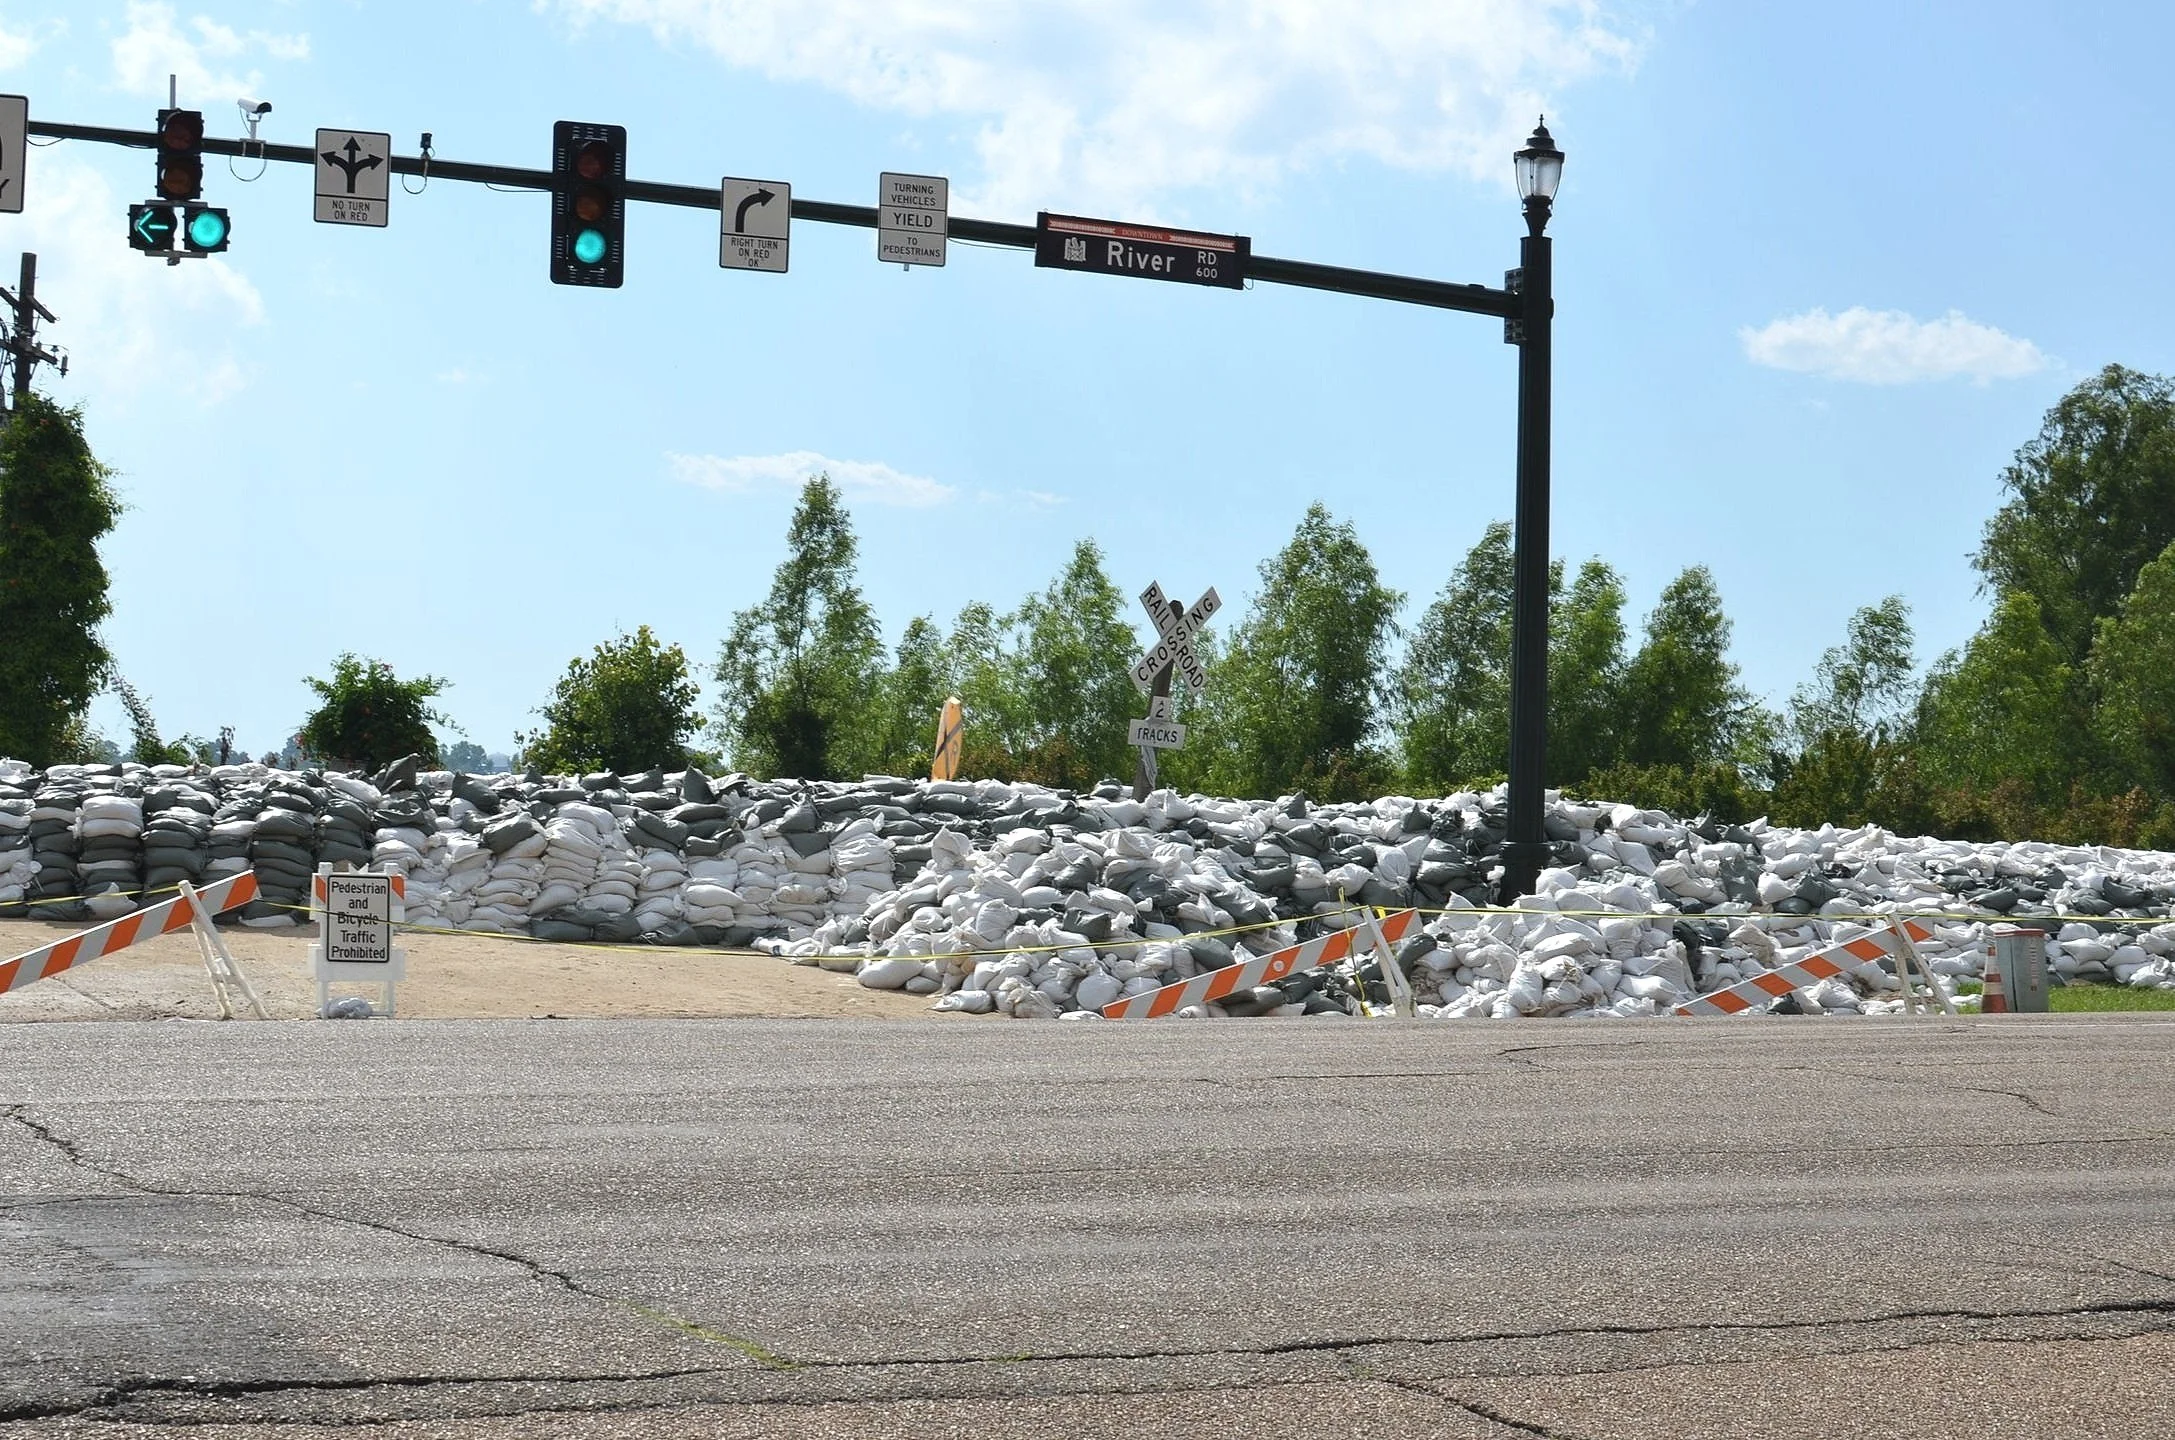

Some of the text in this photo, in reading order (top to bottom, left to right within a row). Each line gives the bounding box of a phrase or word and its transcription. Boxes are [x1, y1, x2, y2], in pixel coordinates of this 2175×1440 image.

[894, 183, 934, 194] TURNING
[332, 200, 370, 211] NO TURN
[891, 194, 936, 206] VEHICLES
[334, 211, 368, 221] ON RED
[893, 212, 933, 228] YIELD
[1121, 229, 1163, 240] DOWNTOWN
[731, 237, 778, 249] RIGHT TURN
[907, 237, 918, 246] TO
[738, 247, 770, 258] ON RED
[883, 245, 940, 258] PEDESTRIANS
[1107, 240, 1217, 273] River RD
[748, 258, 760, 267] OK
[1196, 267, 1218, 279] 600
[1137, 597, 1214, 682] CROSSING
[1144, 586, 1204, 688] RAIL ROAD
[1155, 701, 1164, 718] 2
[1136, 727, 1178, 743] TRACKS
[331, 881, 386, 894] Pedestrian
[348, 897, 368, 909] and
[337, 911, 379, 928] Bicycle
[340, 930, 376, 944] Traffic
[331, 945, 385, 959] Prohibited
